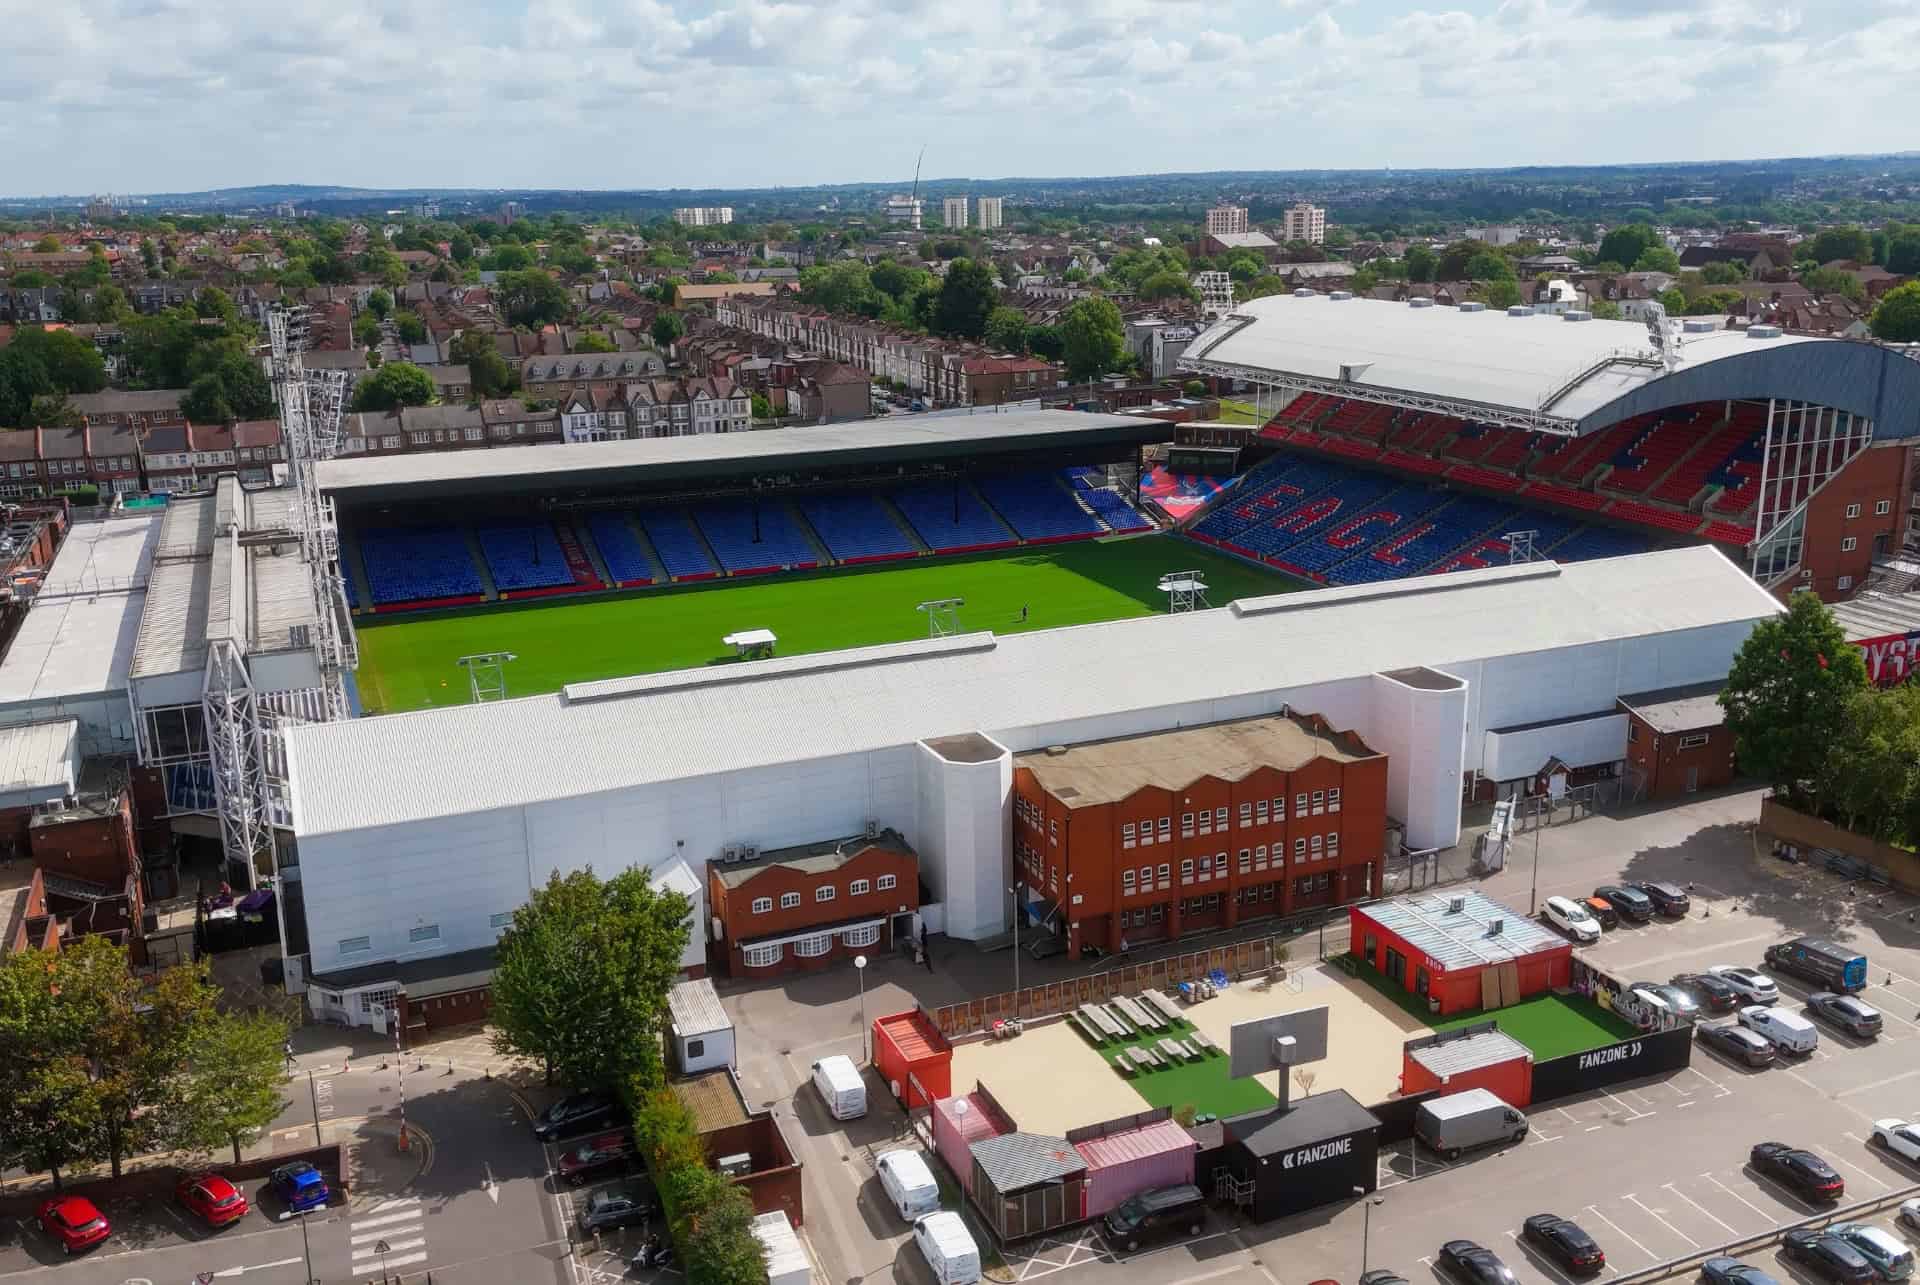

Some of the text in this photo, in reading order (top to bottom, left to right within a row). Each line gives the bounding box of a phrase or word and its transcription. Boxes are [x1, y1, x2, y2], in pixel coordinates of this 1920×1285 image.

[1235, 484, 1567, 574] EAGLE
[1579, 1045, 1628, 1070] FANZONE
[1297, 1137, 1352, 1167] FANZONE
